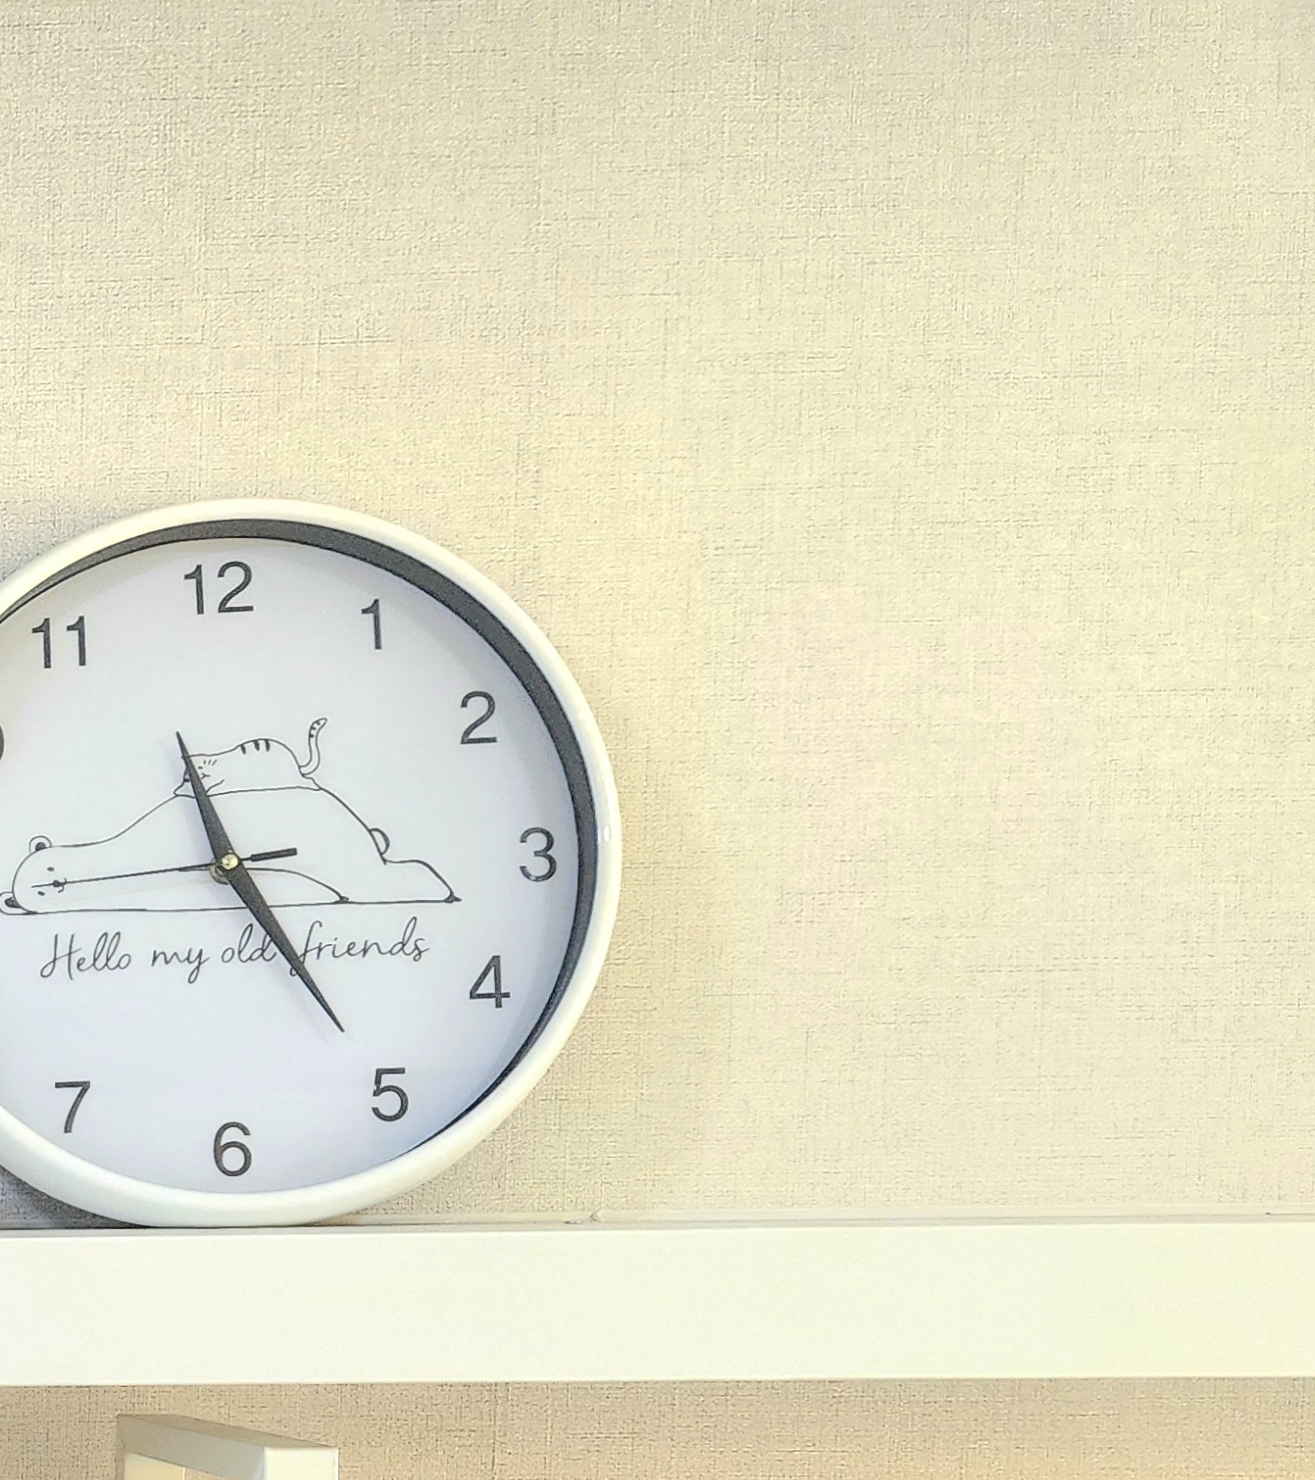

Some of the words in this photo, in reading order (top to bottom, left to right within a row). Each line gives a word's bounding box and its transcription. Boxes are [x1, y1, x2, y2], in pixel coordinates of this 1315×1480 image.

[183, 561, 255, 614] 12
[31, 616, 88, 669] 11
[360, 599, 384, 650] 1
[459, 691, 498, 745] 2
[518, 828, 557, 881] 3
[40, 932, 131, 980] Hello
[151, 945, 210, 984] my
[221, 924, 277, 964] old
[289, 917, 430, 977] friends
[468, 955, 510, 1009] 4
[53, 1081, 92, 1134] 7
[370, 1068, 410, 1121] 5
[213, 1122, 253, 1176] 6
